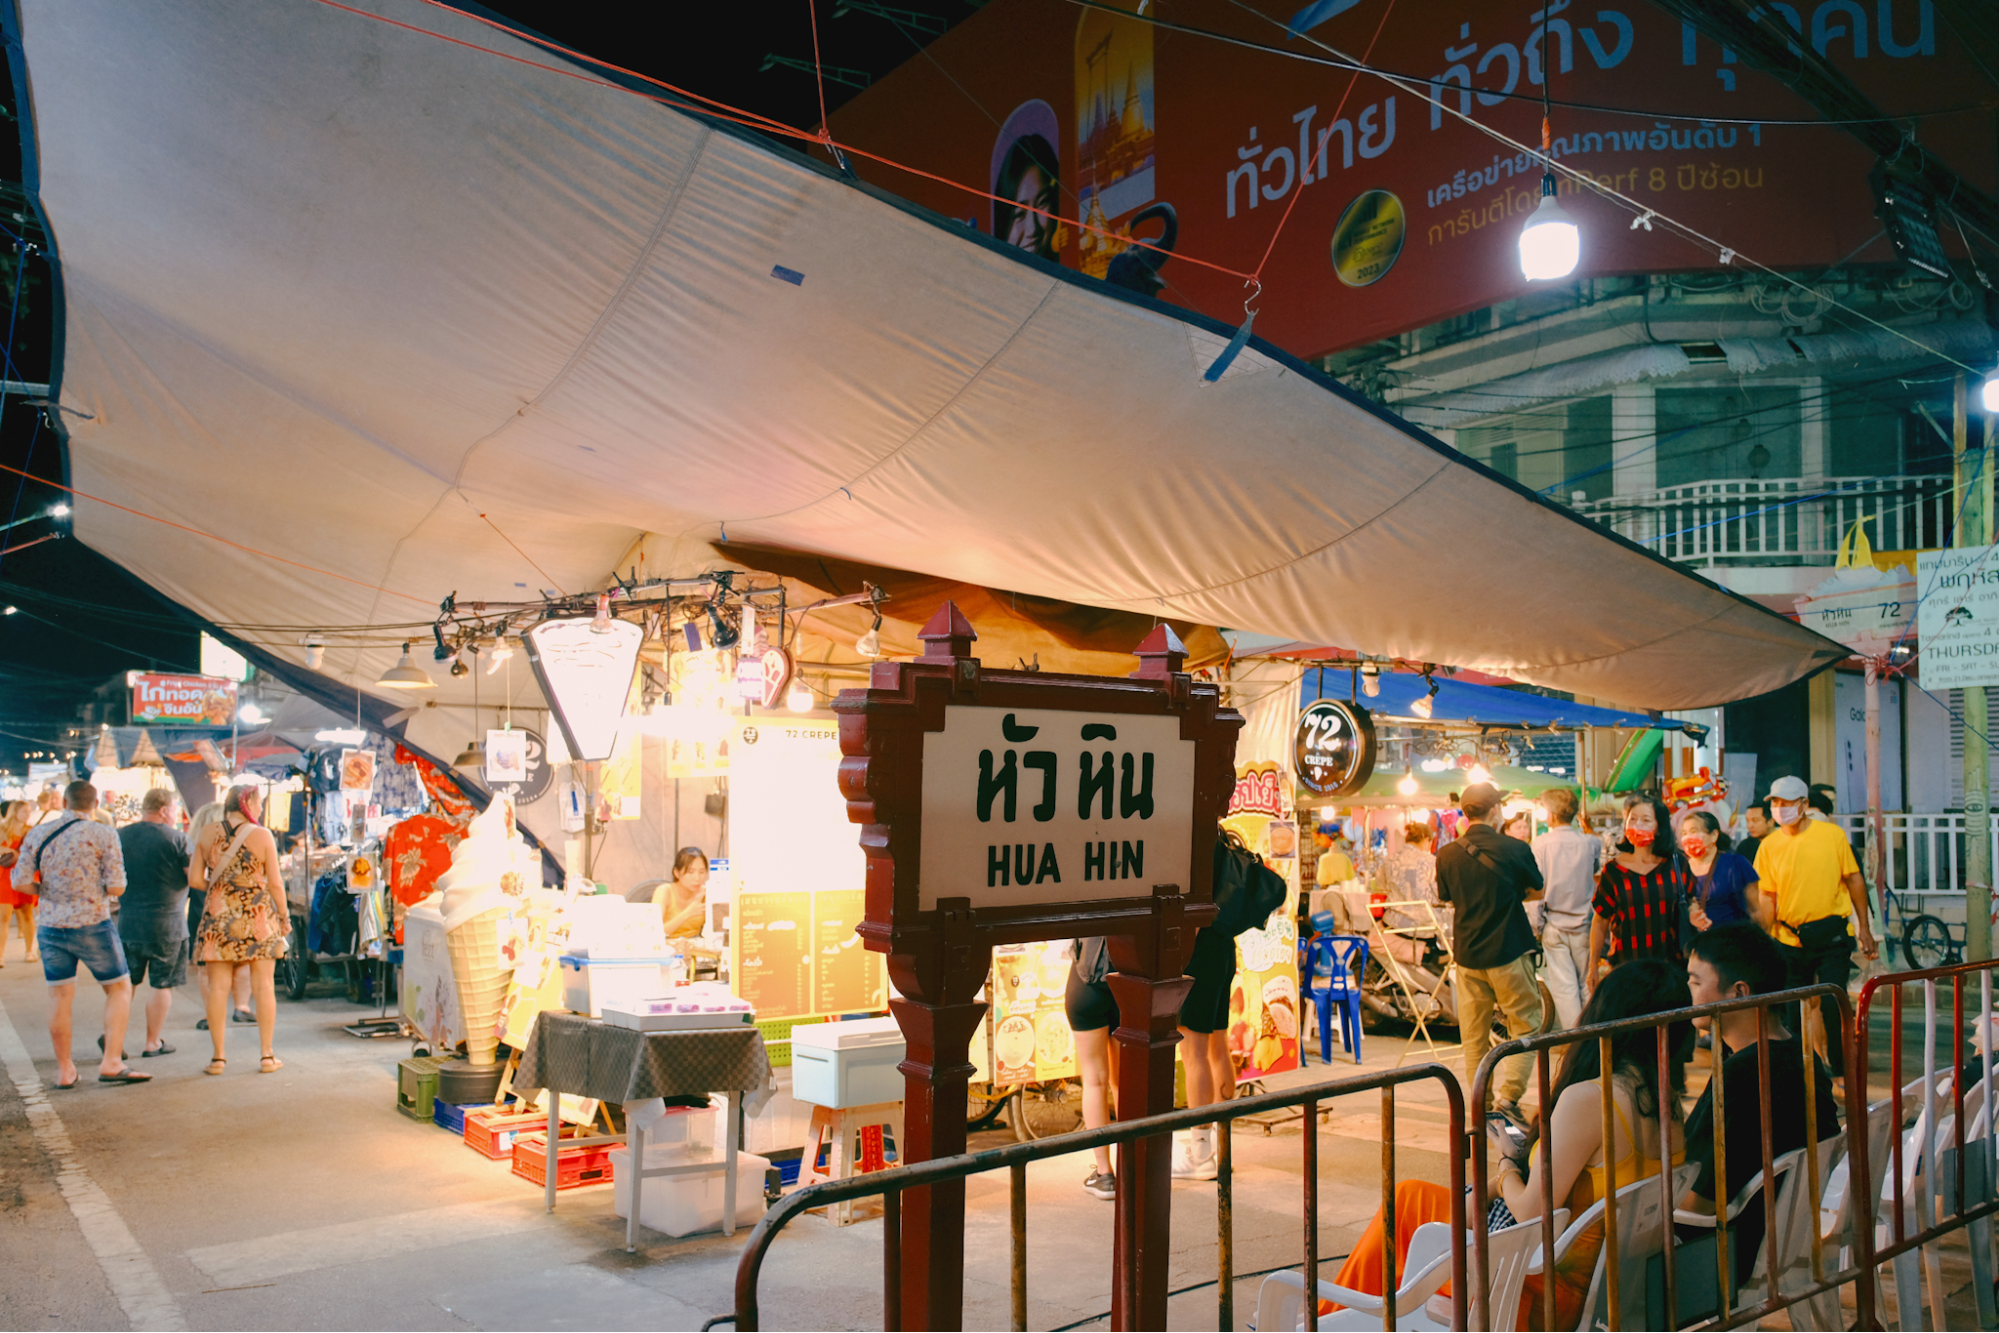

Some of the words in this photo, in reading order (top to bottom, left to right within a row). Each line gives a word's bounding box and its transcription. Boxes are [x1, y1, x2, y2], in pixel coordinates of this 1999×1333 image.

[1748, 124, 1762, 147] 1
[1226, 96, 1397, 219] ทั่วไทย
[1648, 168, 1667, 192] 8
[1357, 263, 1380, 279] 2023
[1878, 601, 1901, 619] 72
[1984, 627, 1991, 636] 4
[138, 679, 203, 702] ไก่ทอด
[785, 729, 798, 738] 72
[802, 730, 837, 740] CREPE
[1304, 713, 1342, 752] 72
[988, 843, 1061, 887] HUA
[1085, 840, 1144, 881] HIN
